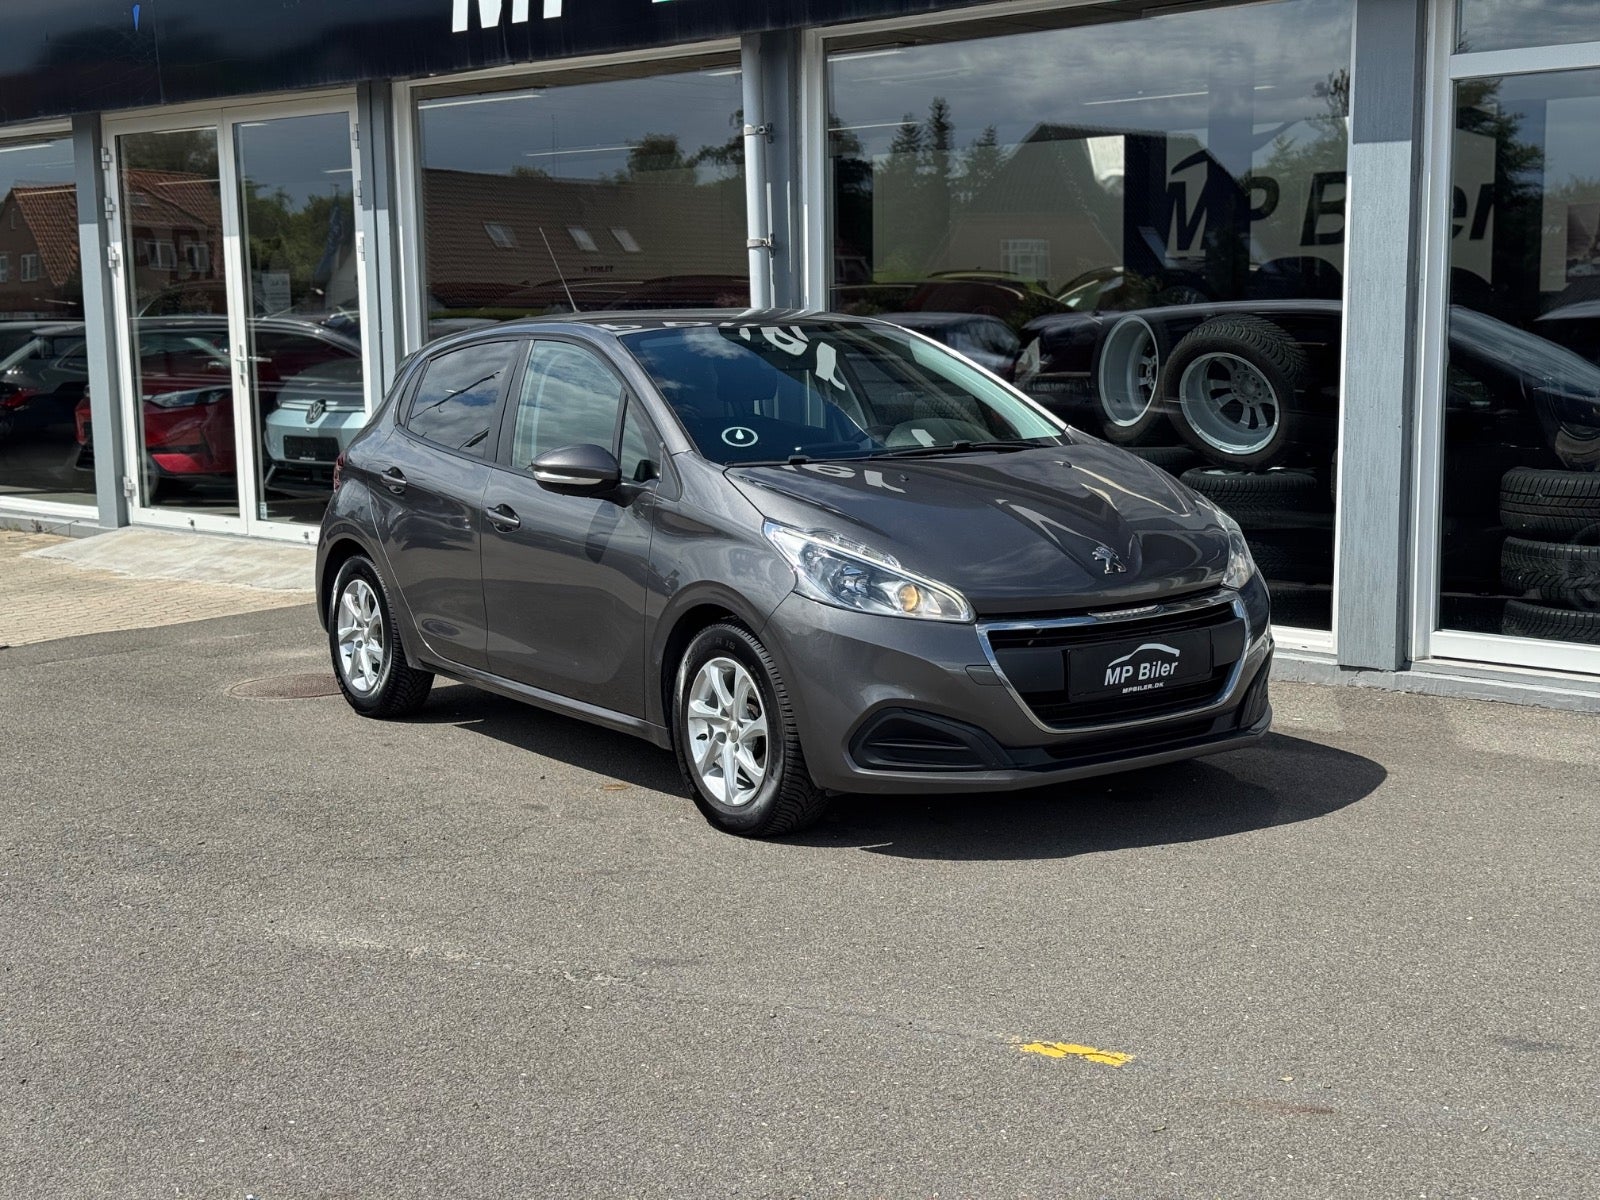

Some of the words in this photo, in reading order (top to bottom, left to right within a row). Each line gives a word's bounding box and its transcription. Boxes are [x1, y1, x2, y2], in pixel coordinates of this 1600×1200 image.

[1104, 665, 1134, 686] MP
[1138, 661, 1179, 681] Biler
[1122, 682, 1164, 694] MPBILER.DK
